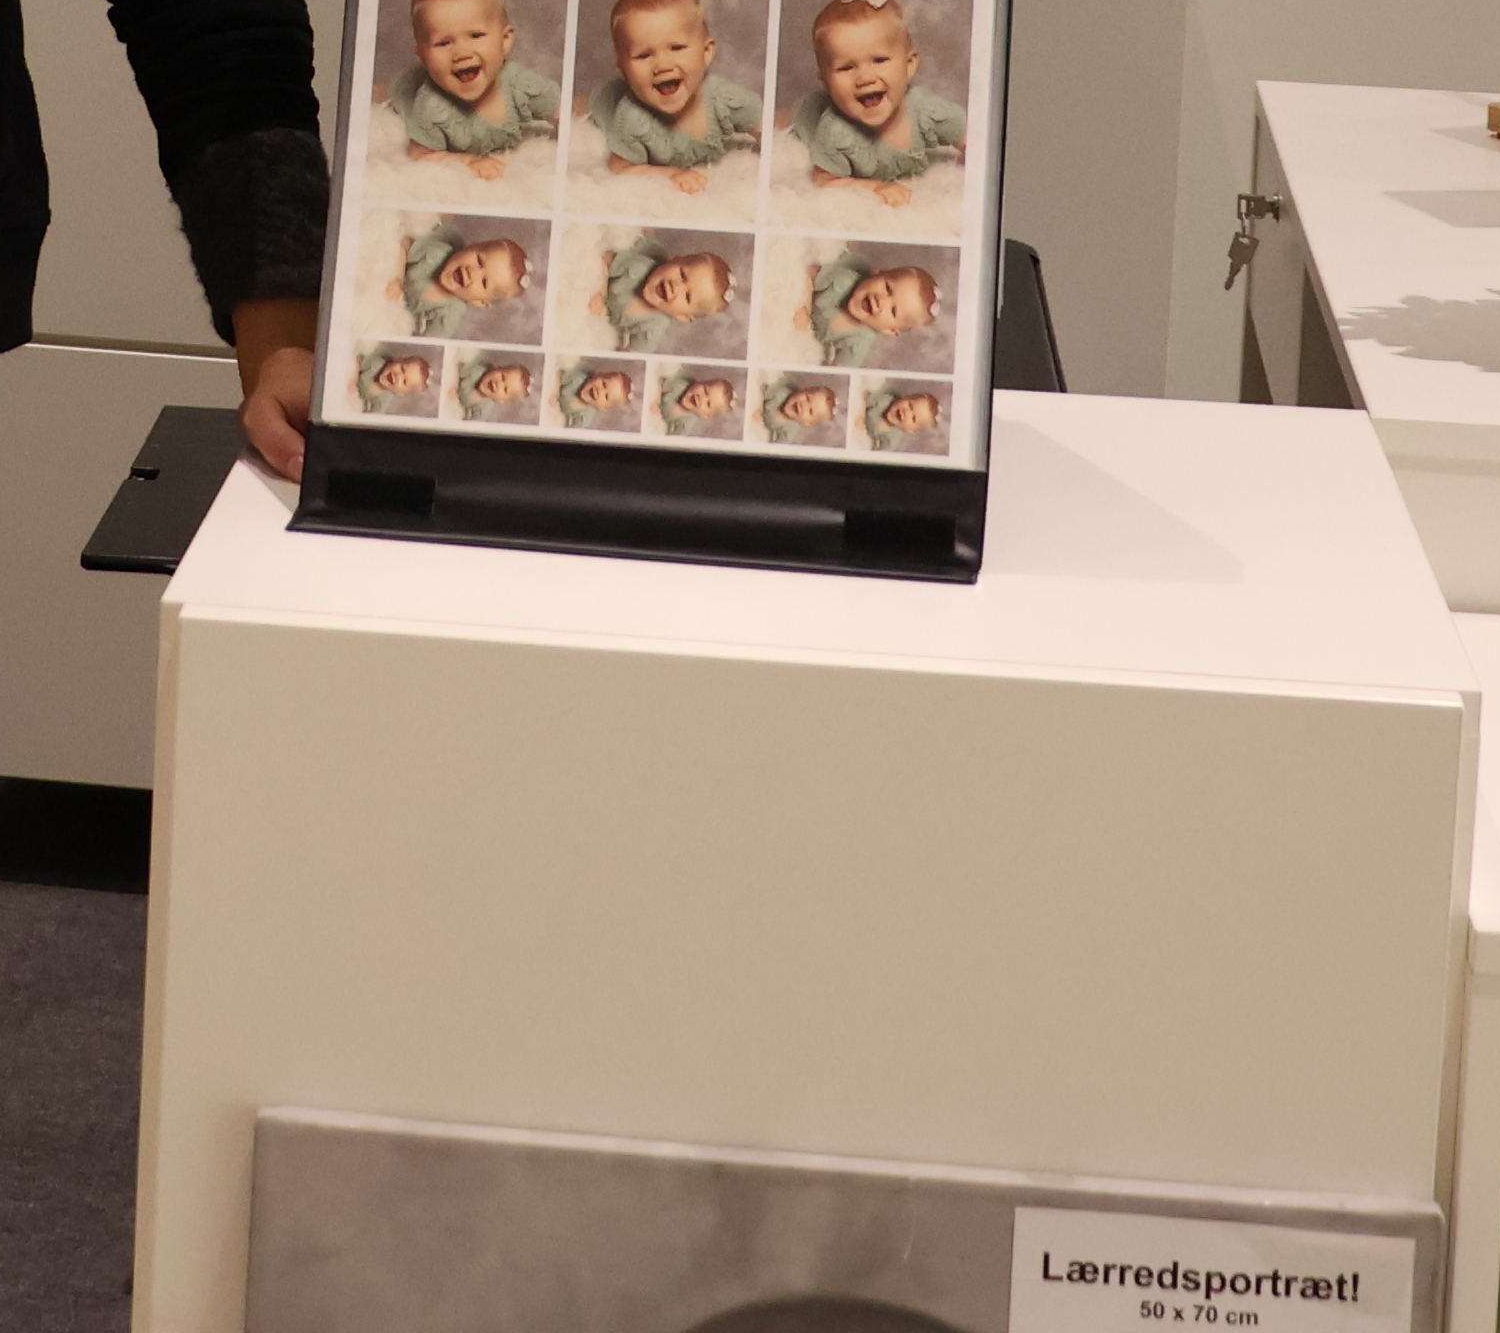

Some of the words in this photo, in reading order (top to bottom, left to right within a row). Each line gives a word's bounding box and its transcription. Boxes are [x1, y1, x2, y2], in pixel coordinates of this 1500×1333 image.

[1042, 1251, 1361, 1302] Lærredsportræt!
[1140, 1300, 1166, 1320] 50
[1173, 1307, 1186, 1322] x
[1194, 1304, 1219, 1324] 70
[1226, 1309, 1260, 1326] cm
